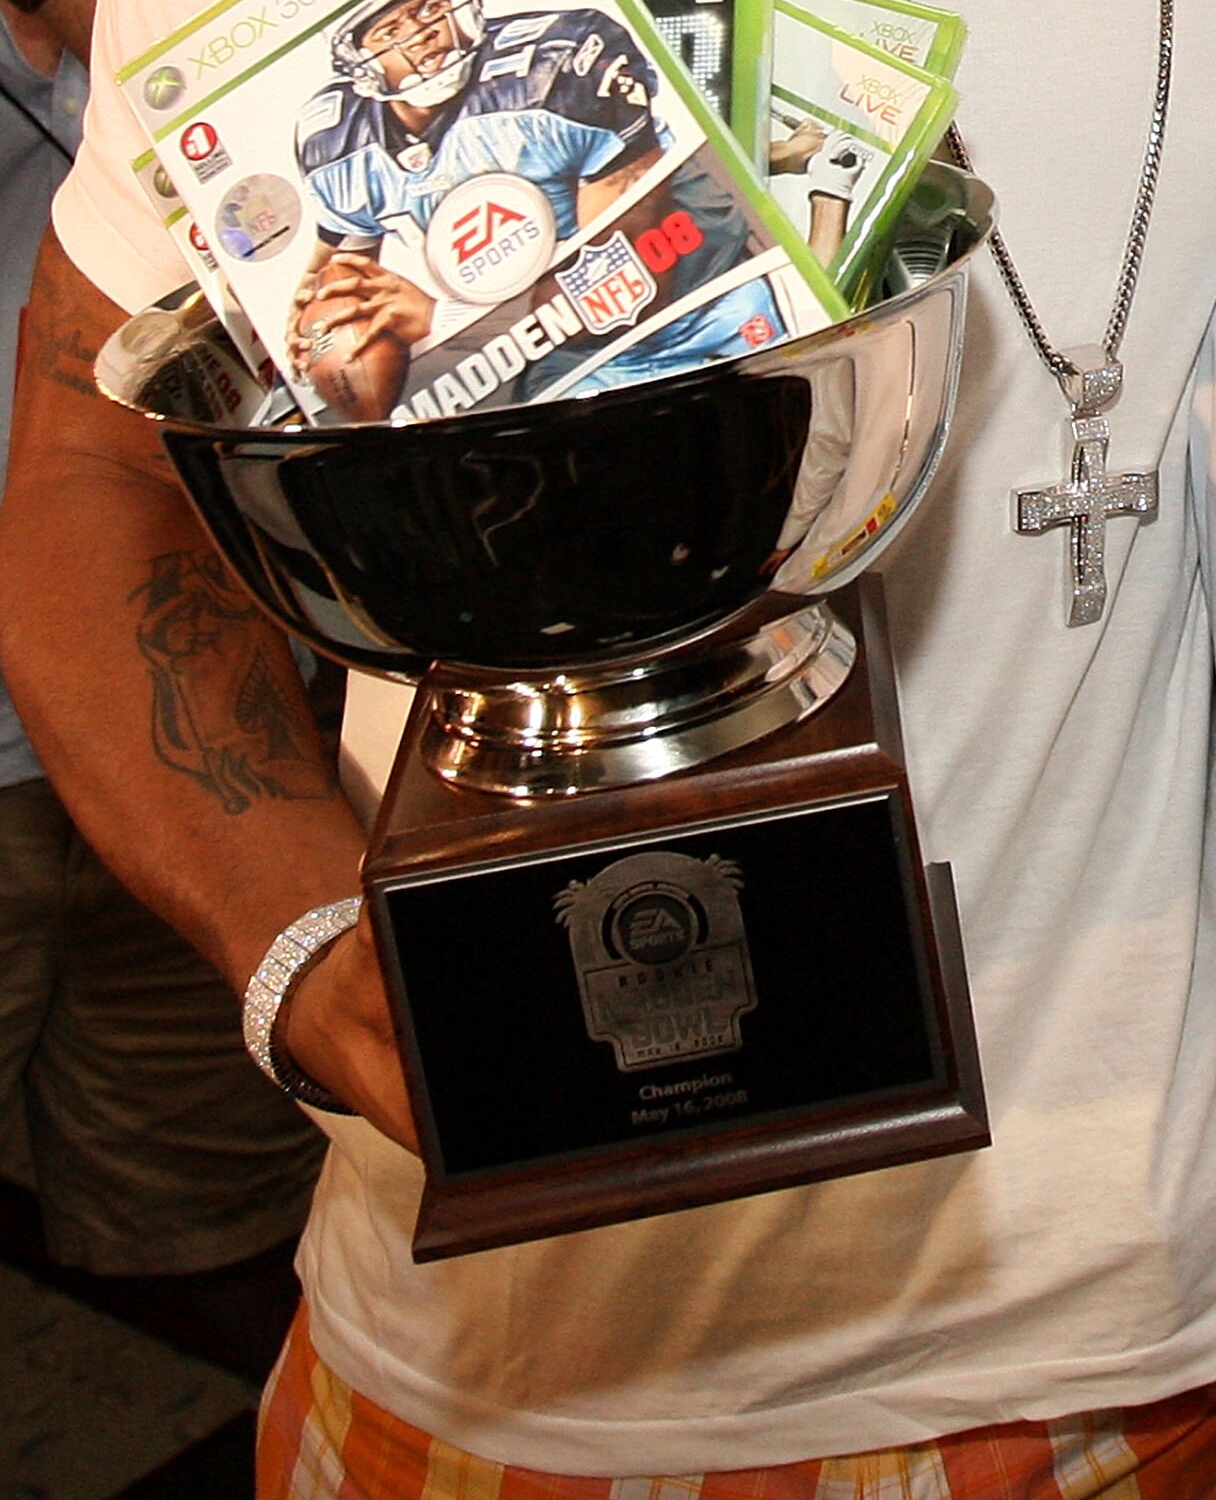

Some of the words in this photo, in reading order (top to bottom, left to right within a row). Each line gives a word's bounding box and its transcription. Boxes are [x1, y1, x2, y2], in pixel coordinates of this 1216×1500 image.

[186, 5, 279, 80] XBOX
[870, 20, 916, 45] XBOX
[858, 72, 902, 103] XBOX
[840, 83, 903, 127] LIVE
[451, 200, 528, 266] EA
[459, 220, 541, 285] SPORTS
[390, 294, 584, 420] MADDEN
[583, 269, 646, 324] NFL
[635, 209, 705, 273] 08
[631, 908, 682, 936] EA
[618, 959, 715, 989] ROOKIE
[638, 1073, 733, 1101] Champion
[631, 1105, 670, 1125] May
[675, 1101, 702, 1117] 16,
